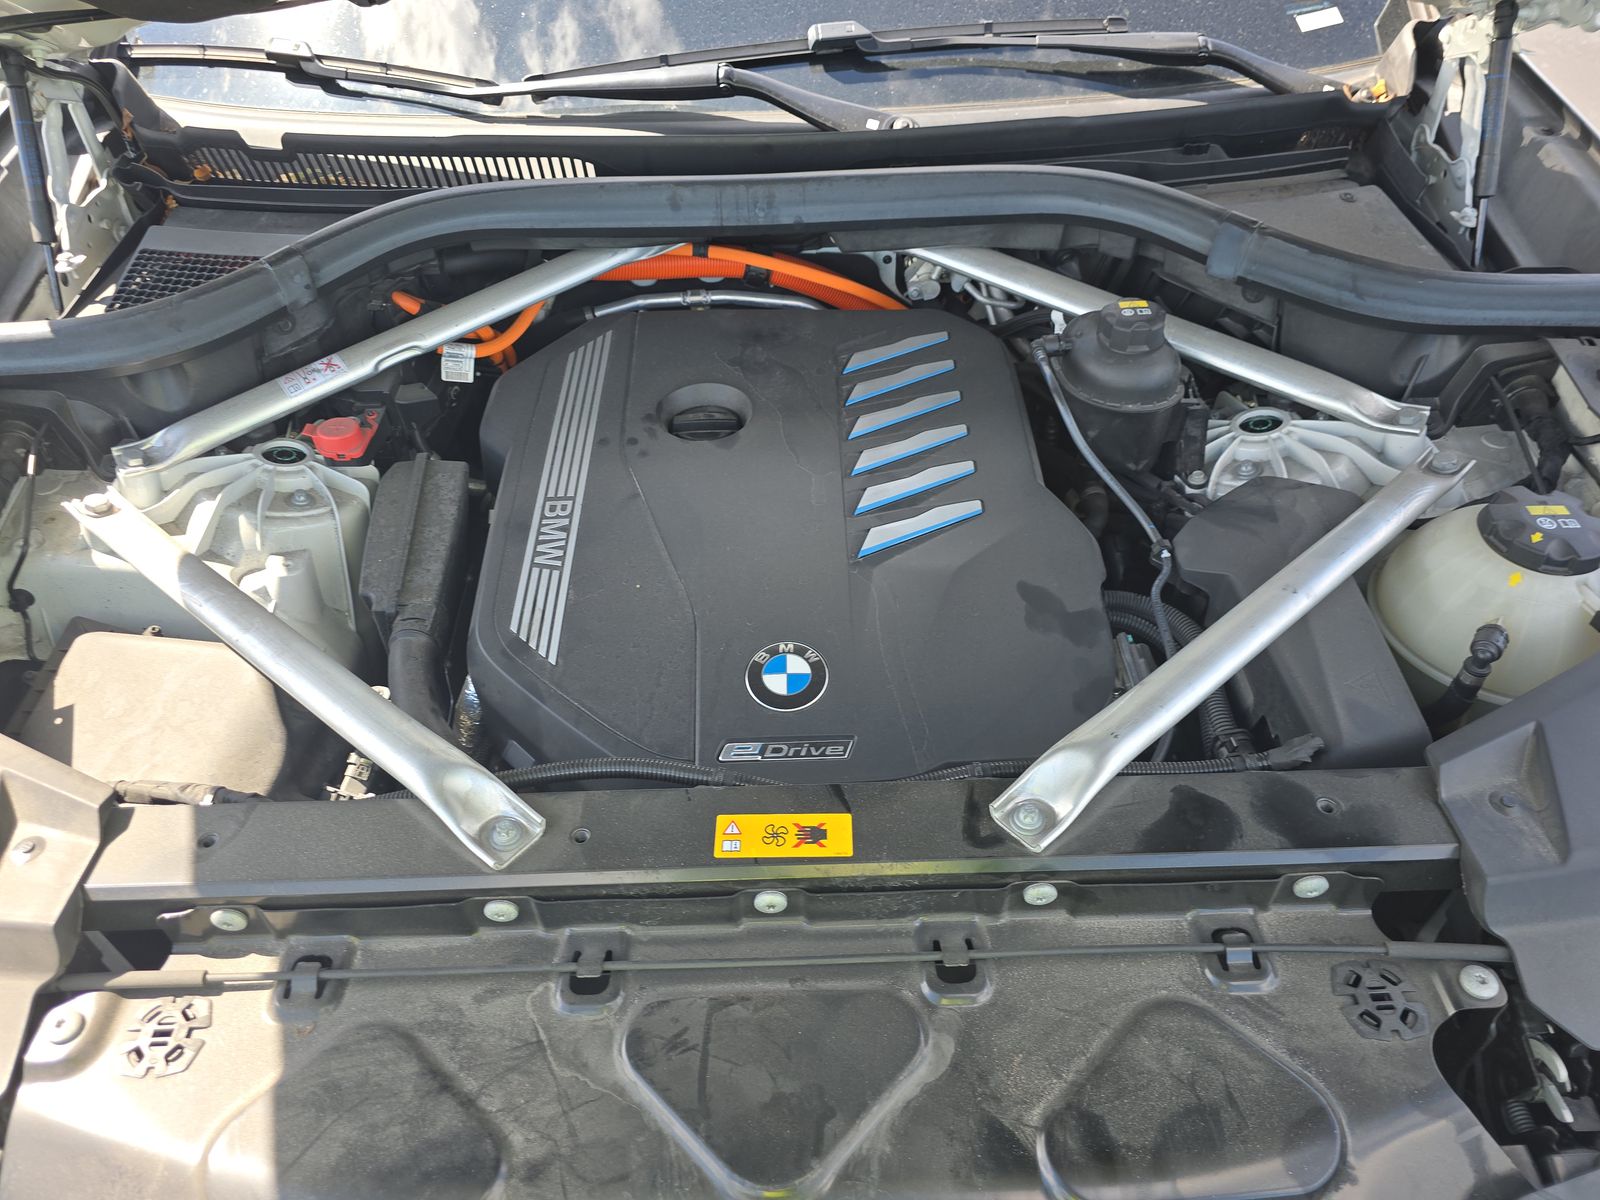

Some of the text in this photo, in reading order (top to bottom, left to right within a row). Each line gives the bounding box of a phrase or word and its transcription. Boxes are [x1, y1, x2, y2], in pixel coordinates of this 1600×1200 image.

[533, 500, 574, 567] BMW
[754, 643, 820, 665] BMW
[722, 742, 845, 760] eDrive
